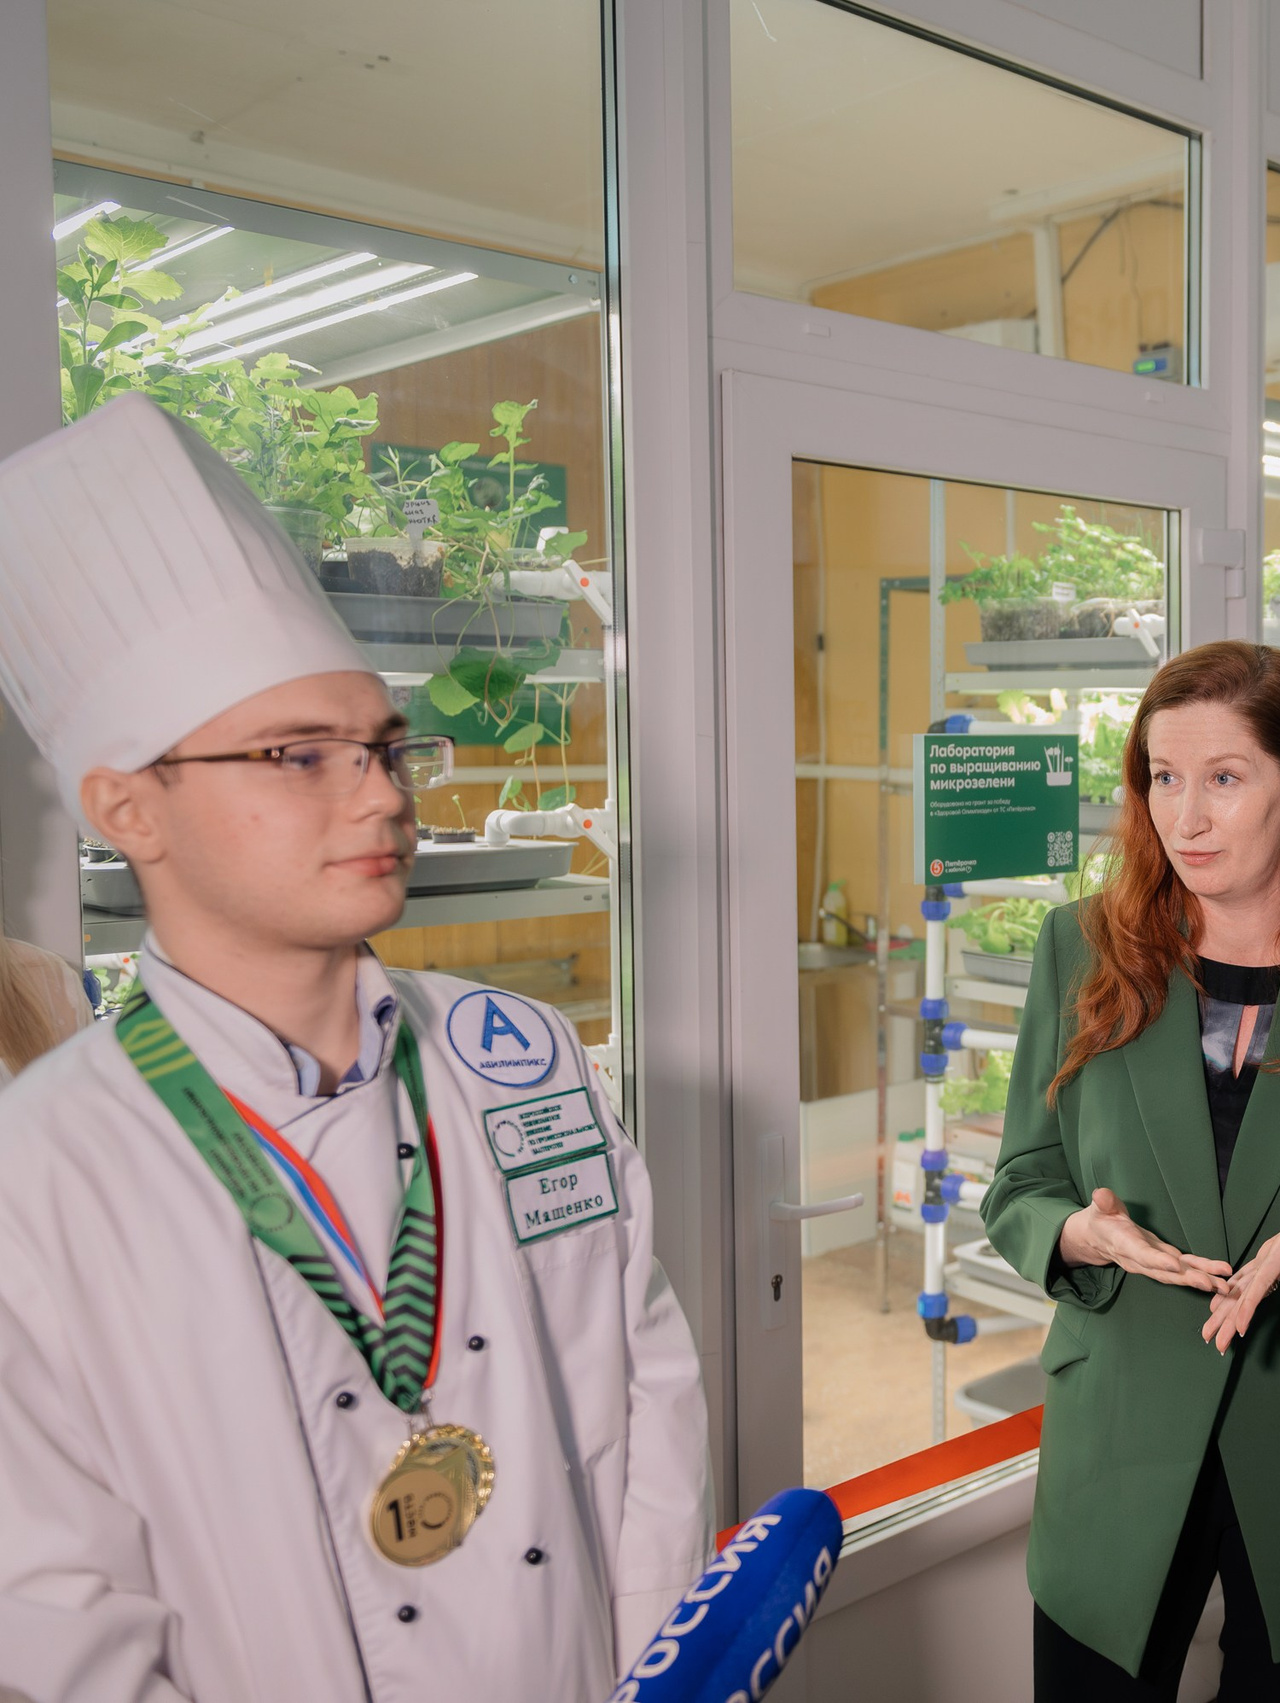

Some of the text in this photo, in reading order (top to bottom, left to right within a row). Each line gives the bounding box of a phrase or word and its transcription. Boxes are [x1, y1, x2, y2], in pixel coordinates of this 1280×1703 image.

[930, 744, 1015, 760] Лаборатория
[930, 760, 1041, 776] по выращиванию
[930, 776, 1015, 792] микрозелени
[540, 1173, 578, 1195] Егор
[387, 1498, 404, 1542] 1
